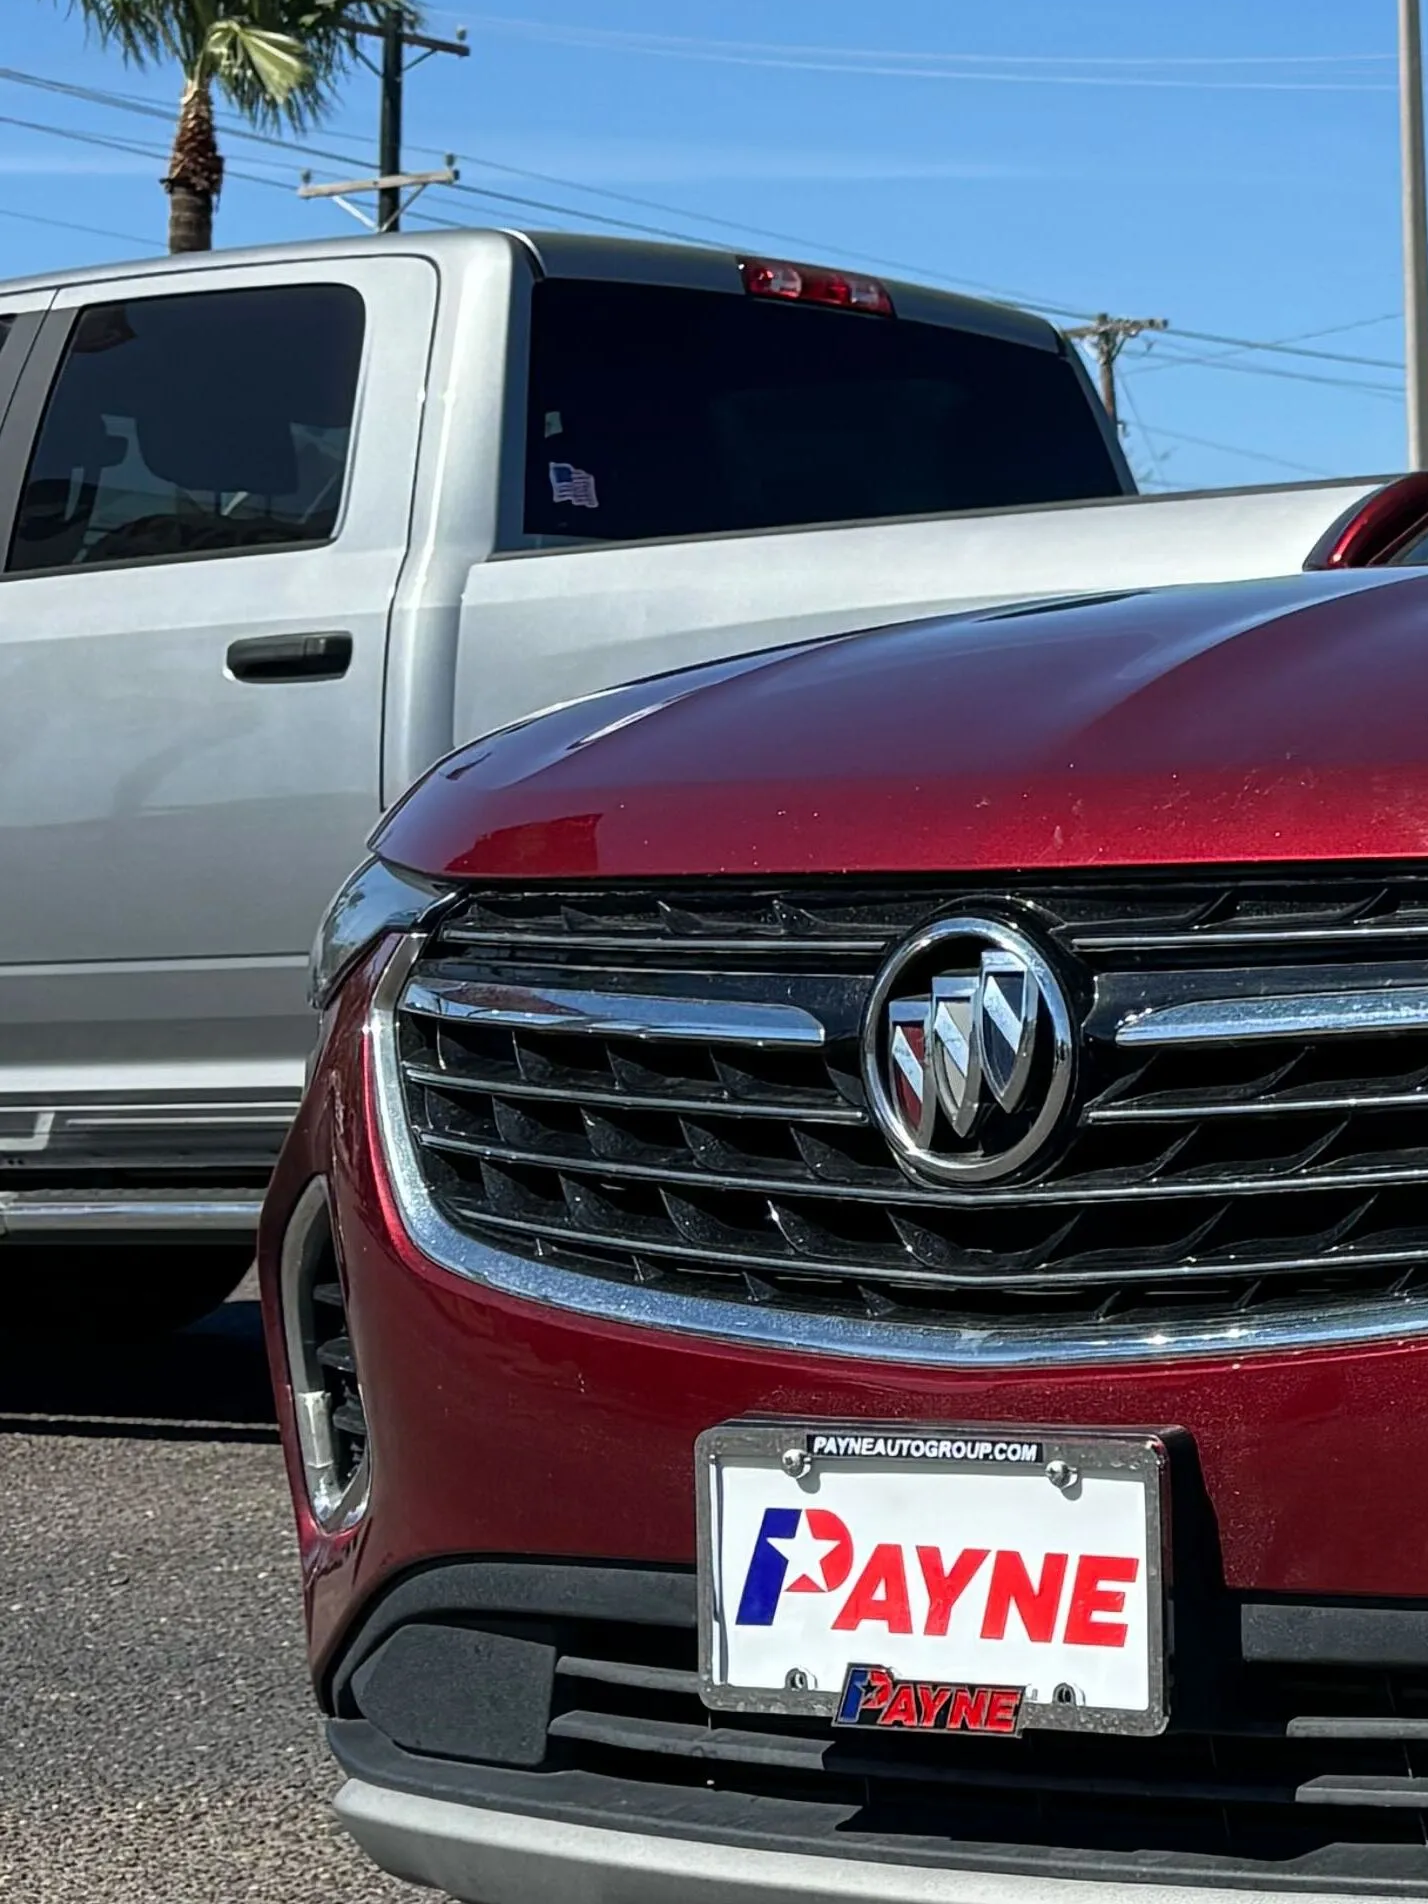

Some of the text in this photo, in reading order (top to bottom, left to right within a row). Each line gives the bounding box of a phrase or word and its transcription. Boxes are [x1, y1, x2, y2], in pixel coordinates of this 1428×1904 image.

[813, 1436, 1037, 1462] PAYNEAUTOGROUP.COM
[735, 1507, 1139, 1648] PAYNE
[838, 1667, 1022, 1733] PAYNE
